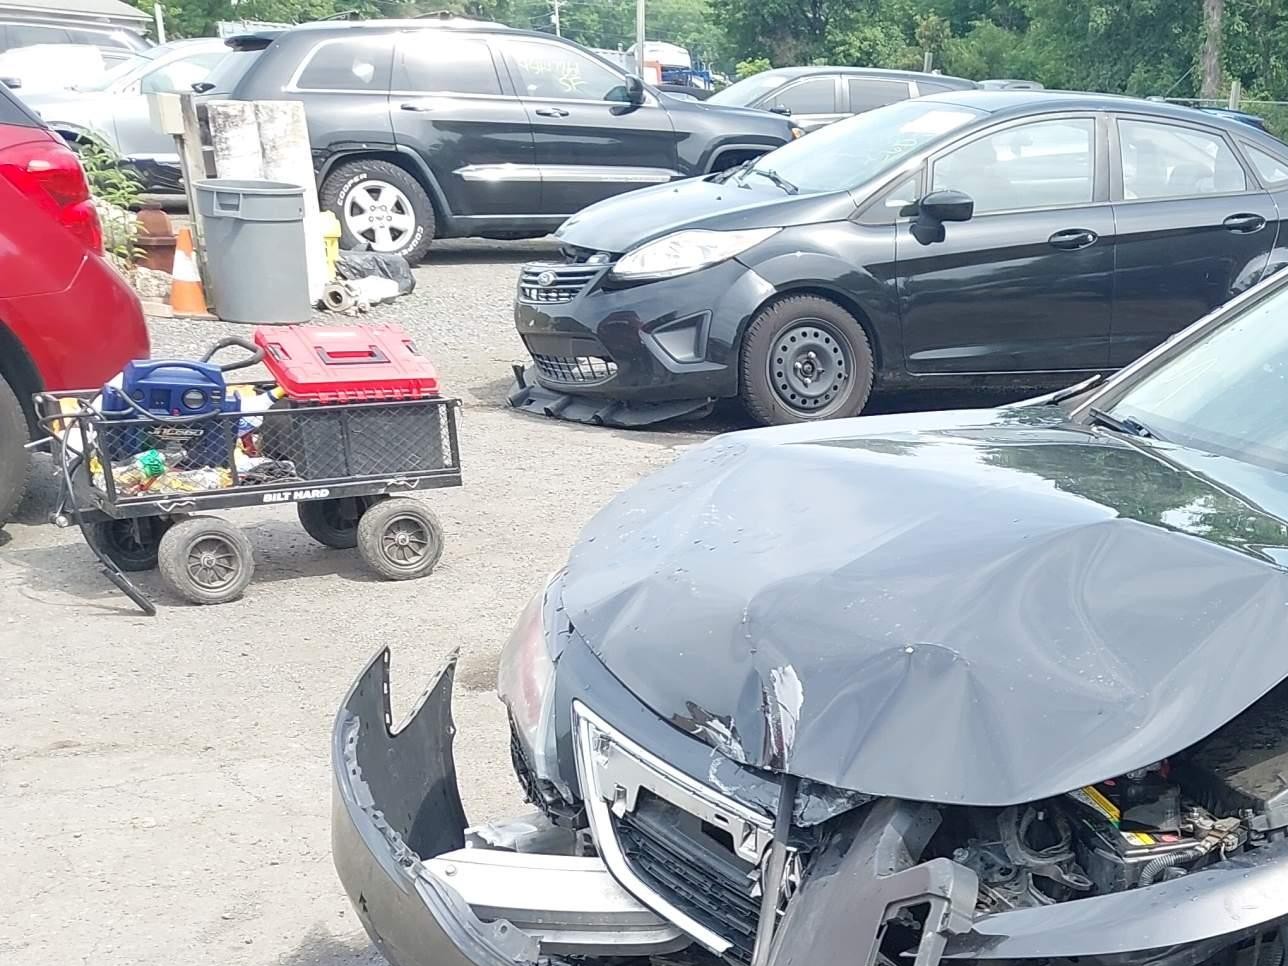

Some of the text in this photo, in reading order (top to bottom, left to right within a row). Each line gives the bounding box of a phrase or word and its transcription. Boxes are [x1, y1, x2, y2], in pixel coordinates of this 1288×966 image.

[337, 173, 368, 206] COOPER
[263, 488, 330, 502] BILT HARD
